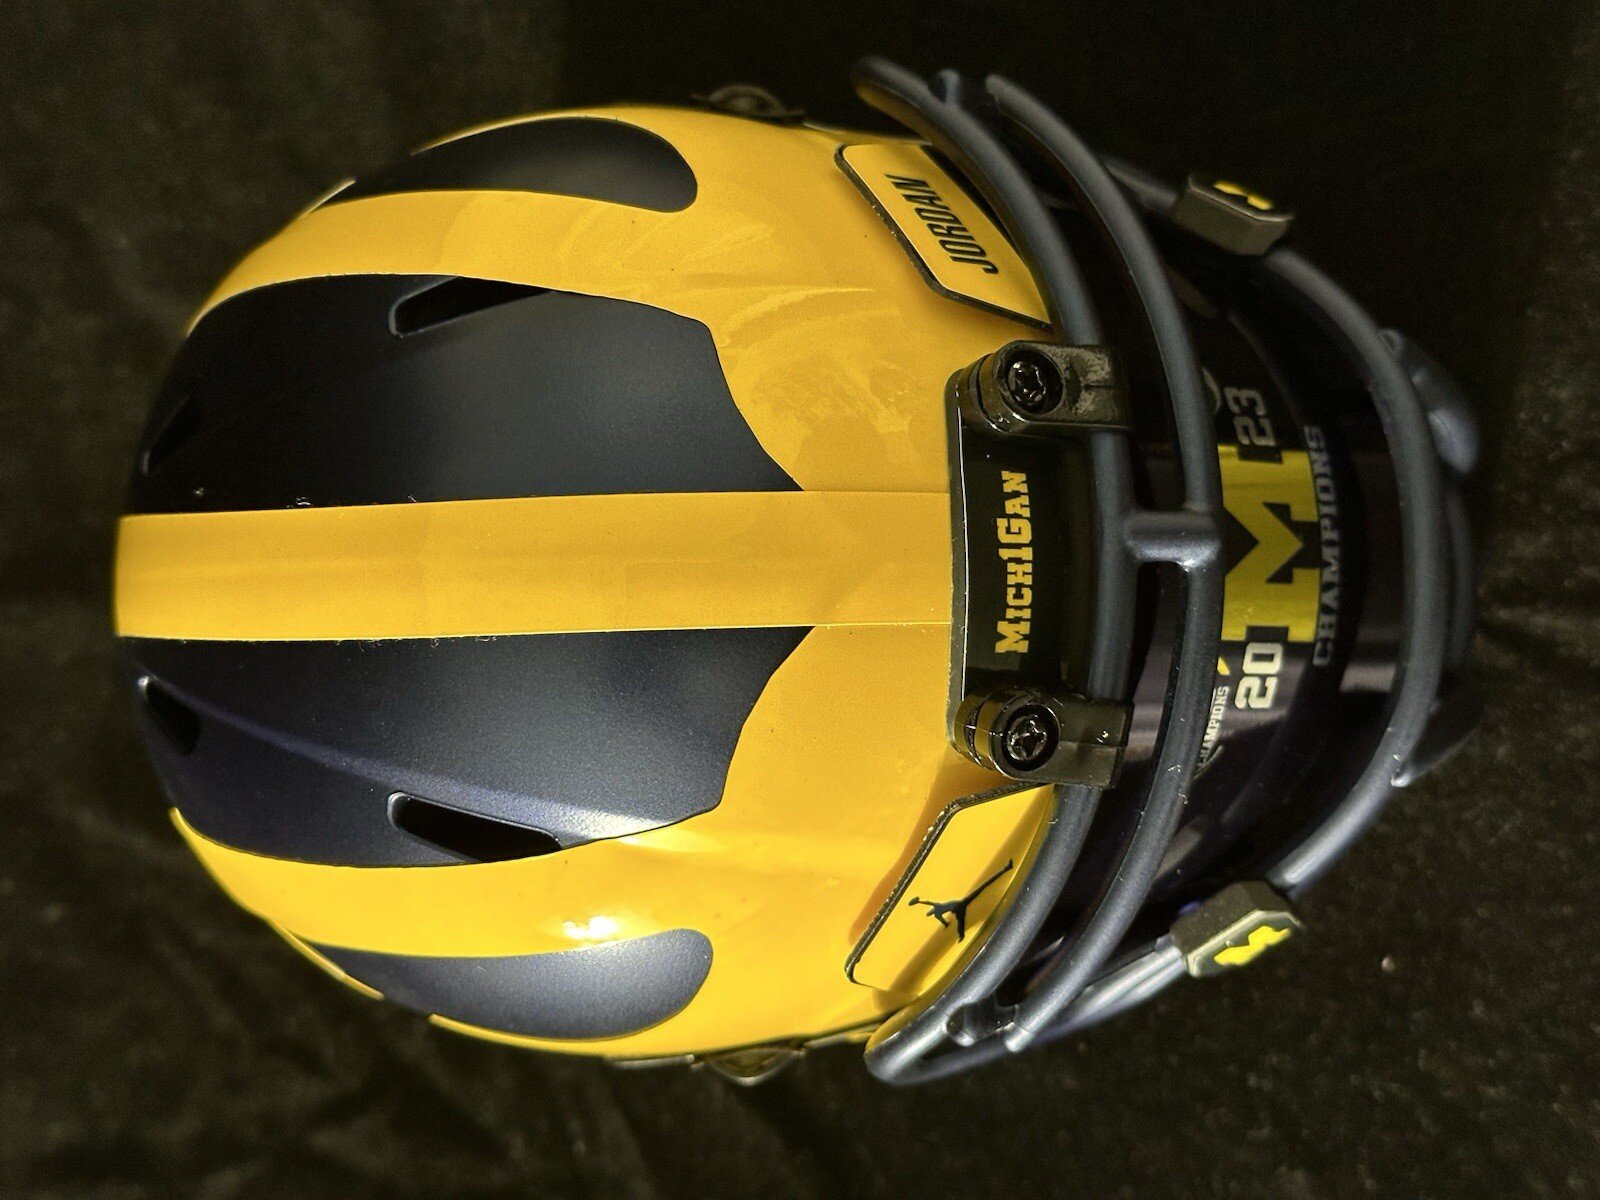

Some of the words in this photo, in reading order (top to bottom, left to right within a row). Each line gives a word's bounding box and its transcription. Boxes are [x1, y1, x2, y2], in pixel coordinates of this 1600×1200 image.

[884, 173, 999, 275] JORDAN
[1223, 386, 1277, 447] 23
[1217, 443, 1322, 643] M
[1303, 424, 1341, 667] CHAMPIONS
[1234, 642, 1283, 709] 20
